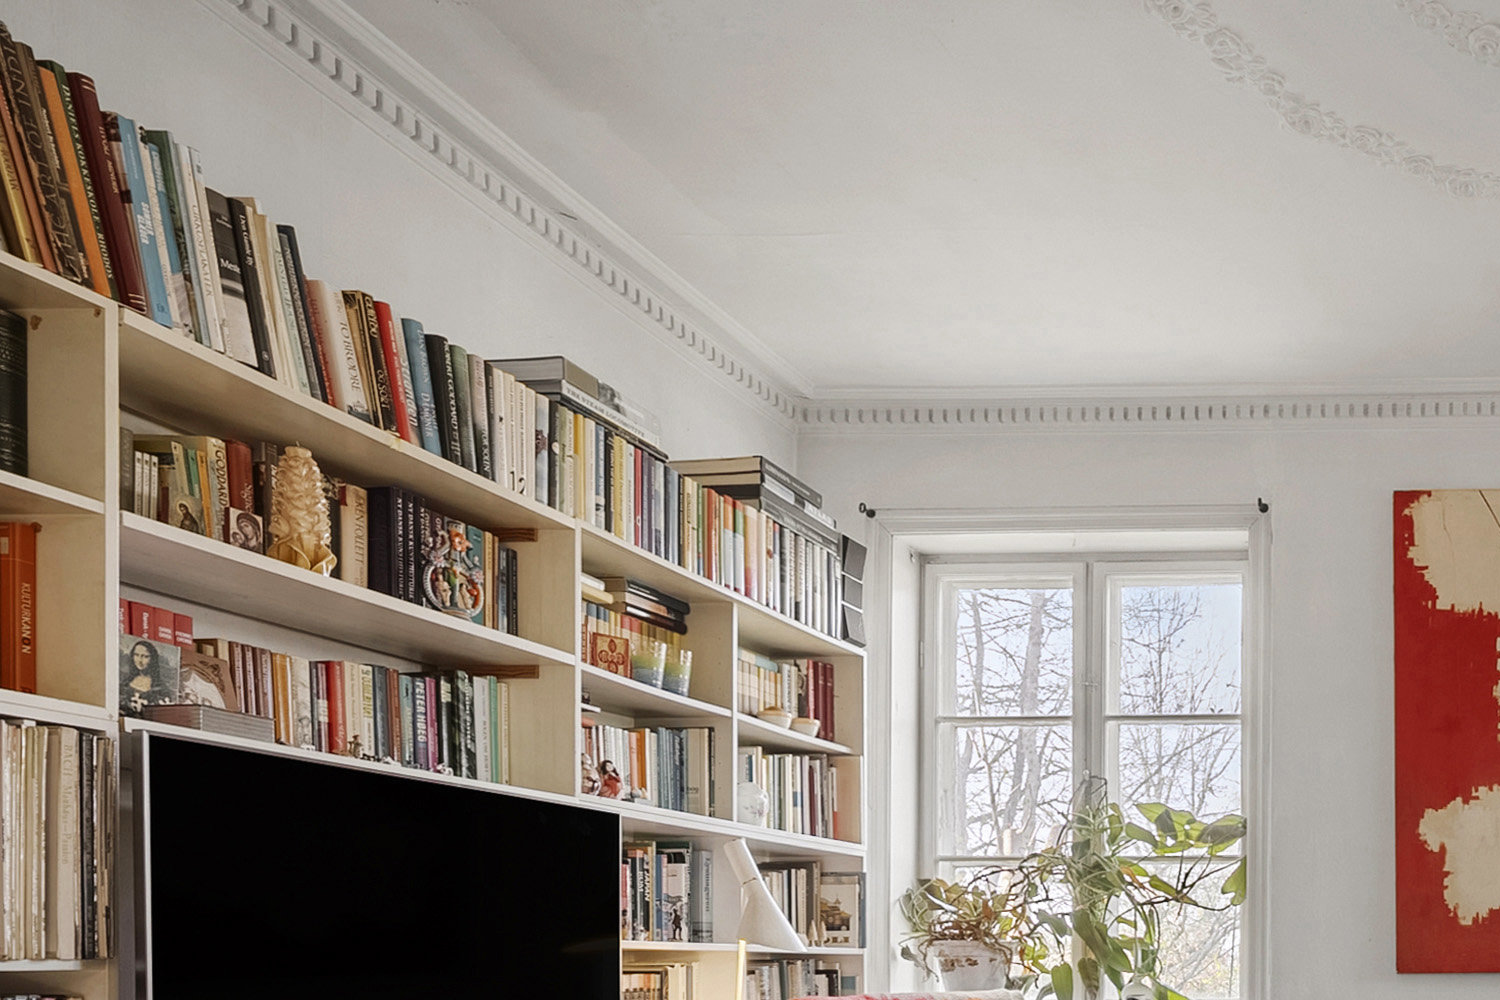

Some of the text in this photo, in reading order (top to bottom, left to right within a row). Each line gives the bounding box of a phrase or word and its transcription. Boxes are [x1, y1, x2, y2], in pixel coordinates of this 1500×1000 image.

[60, 84, 81, 140] DANIELS
[75, 142, 101, 223] KOKKESKOLE
[340, 322, 360, 392] TO BRØDRE
[377, 383, 389, 409] SORT
[400, 357, 418, 427] Stranden
[447, 379, 458, 429] GODDARD
[566, 387, 581, 400] THE
[582, 398, 605, 414] STEAM
[215, 450, 227, 506] GODDARD
[397, 498, 402, 509] NY
[408, 502, 413, 513] NY
[355, 500, 365, 565] KEN FOLLETT
[21, 583, 32, 654] KULTURKANON
[415, 682, 425, 712] PETER
[63, 744, 73, 777] BACH
